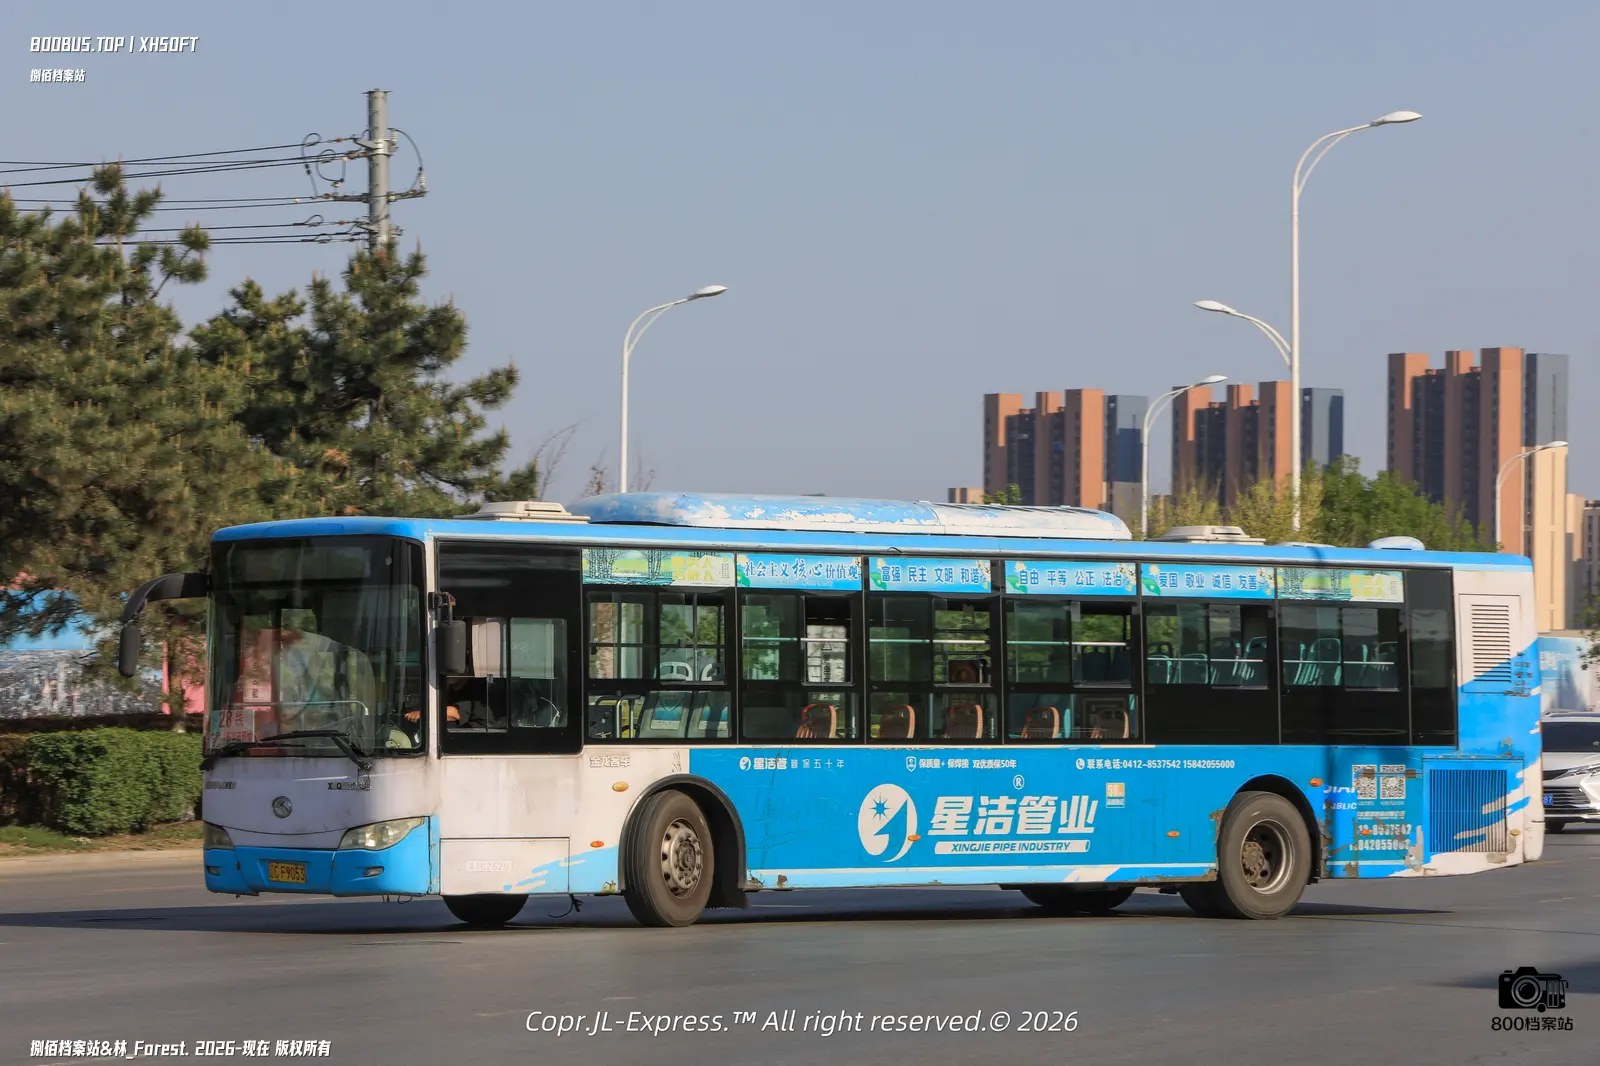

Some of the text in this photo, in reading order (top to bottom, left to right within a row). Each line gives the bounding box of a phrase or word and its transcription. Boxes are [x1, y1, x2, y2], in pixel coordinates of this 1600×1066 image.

[744, 558, 859, 580] 社会主义核心价值观
[881, 565, 980, 584] 富强 民主 文明 和谐
[1019, 569, 1122, 587] 自由 平等 公正 法治
[1159, 571, 1257, 591] 爱国 敬业 诚信 友善
[928, 795, 1099, 836] 星洁管业
[951, 841, 1072, 852] XINGJIE PIPE INDUSTRY
